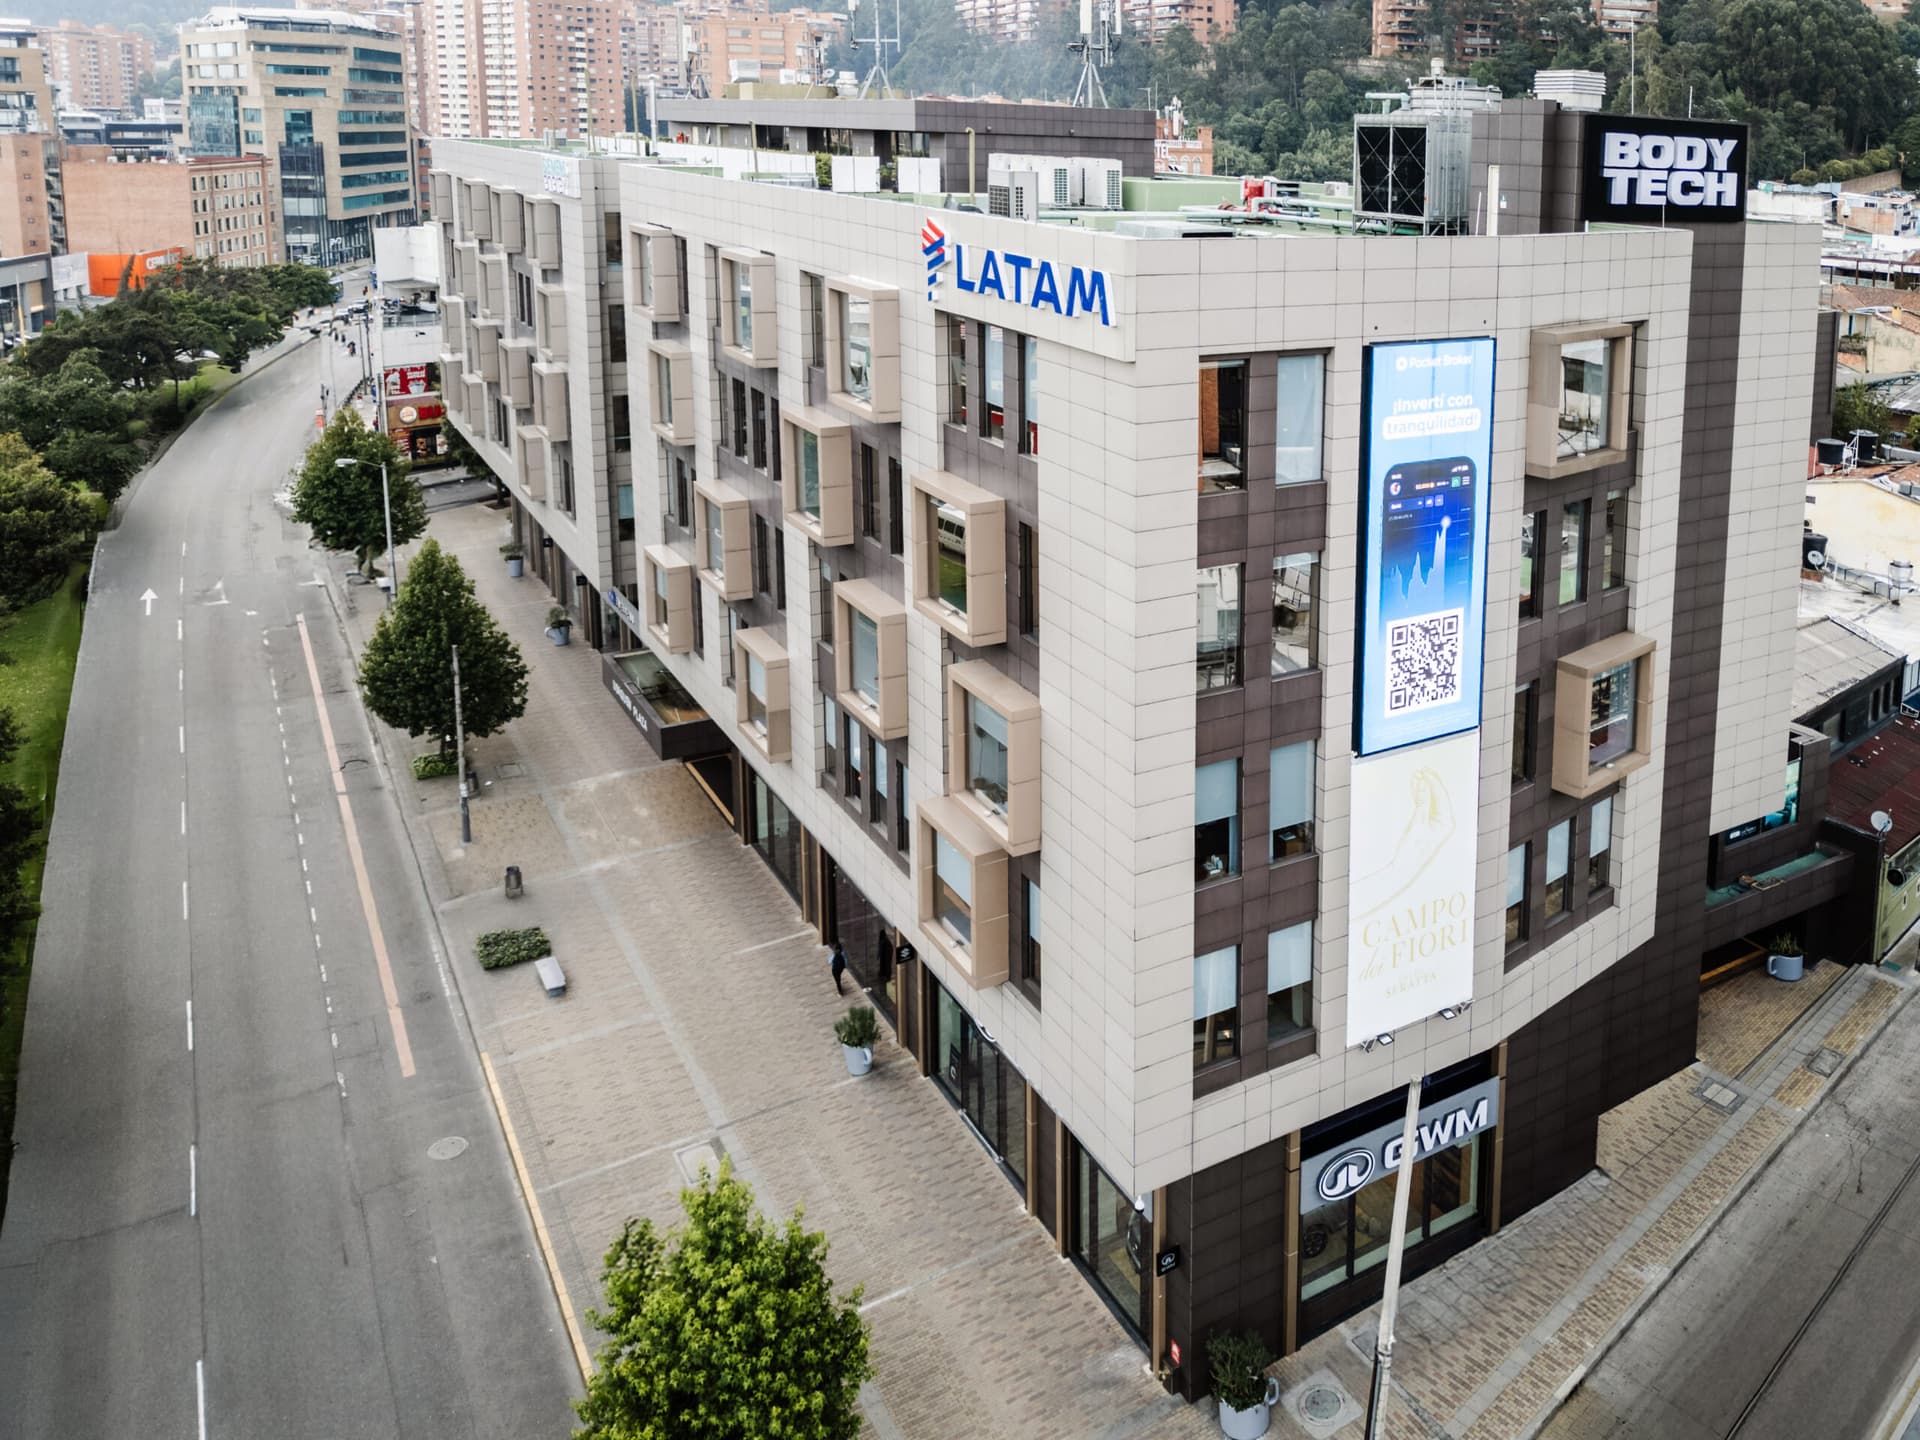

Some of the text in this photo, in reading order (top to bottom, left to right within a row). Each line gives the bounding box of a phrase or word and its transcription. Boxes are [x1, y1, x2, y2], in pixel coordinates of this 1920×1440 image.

[1603, 132, 1738, 171] BODY
[1603, 168, 1738, 206] TECH
[956, 244, 1113, 327] LATAM
[1387, 412, 1478, 434] tranquilidad!
[1448, 395, 1473, 407] con
[1362, 891, 1466, 948] CAMPO
[1392, 918, 1467, 968] FIORI
[1384, 1098, 1489, 1170] GWM
